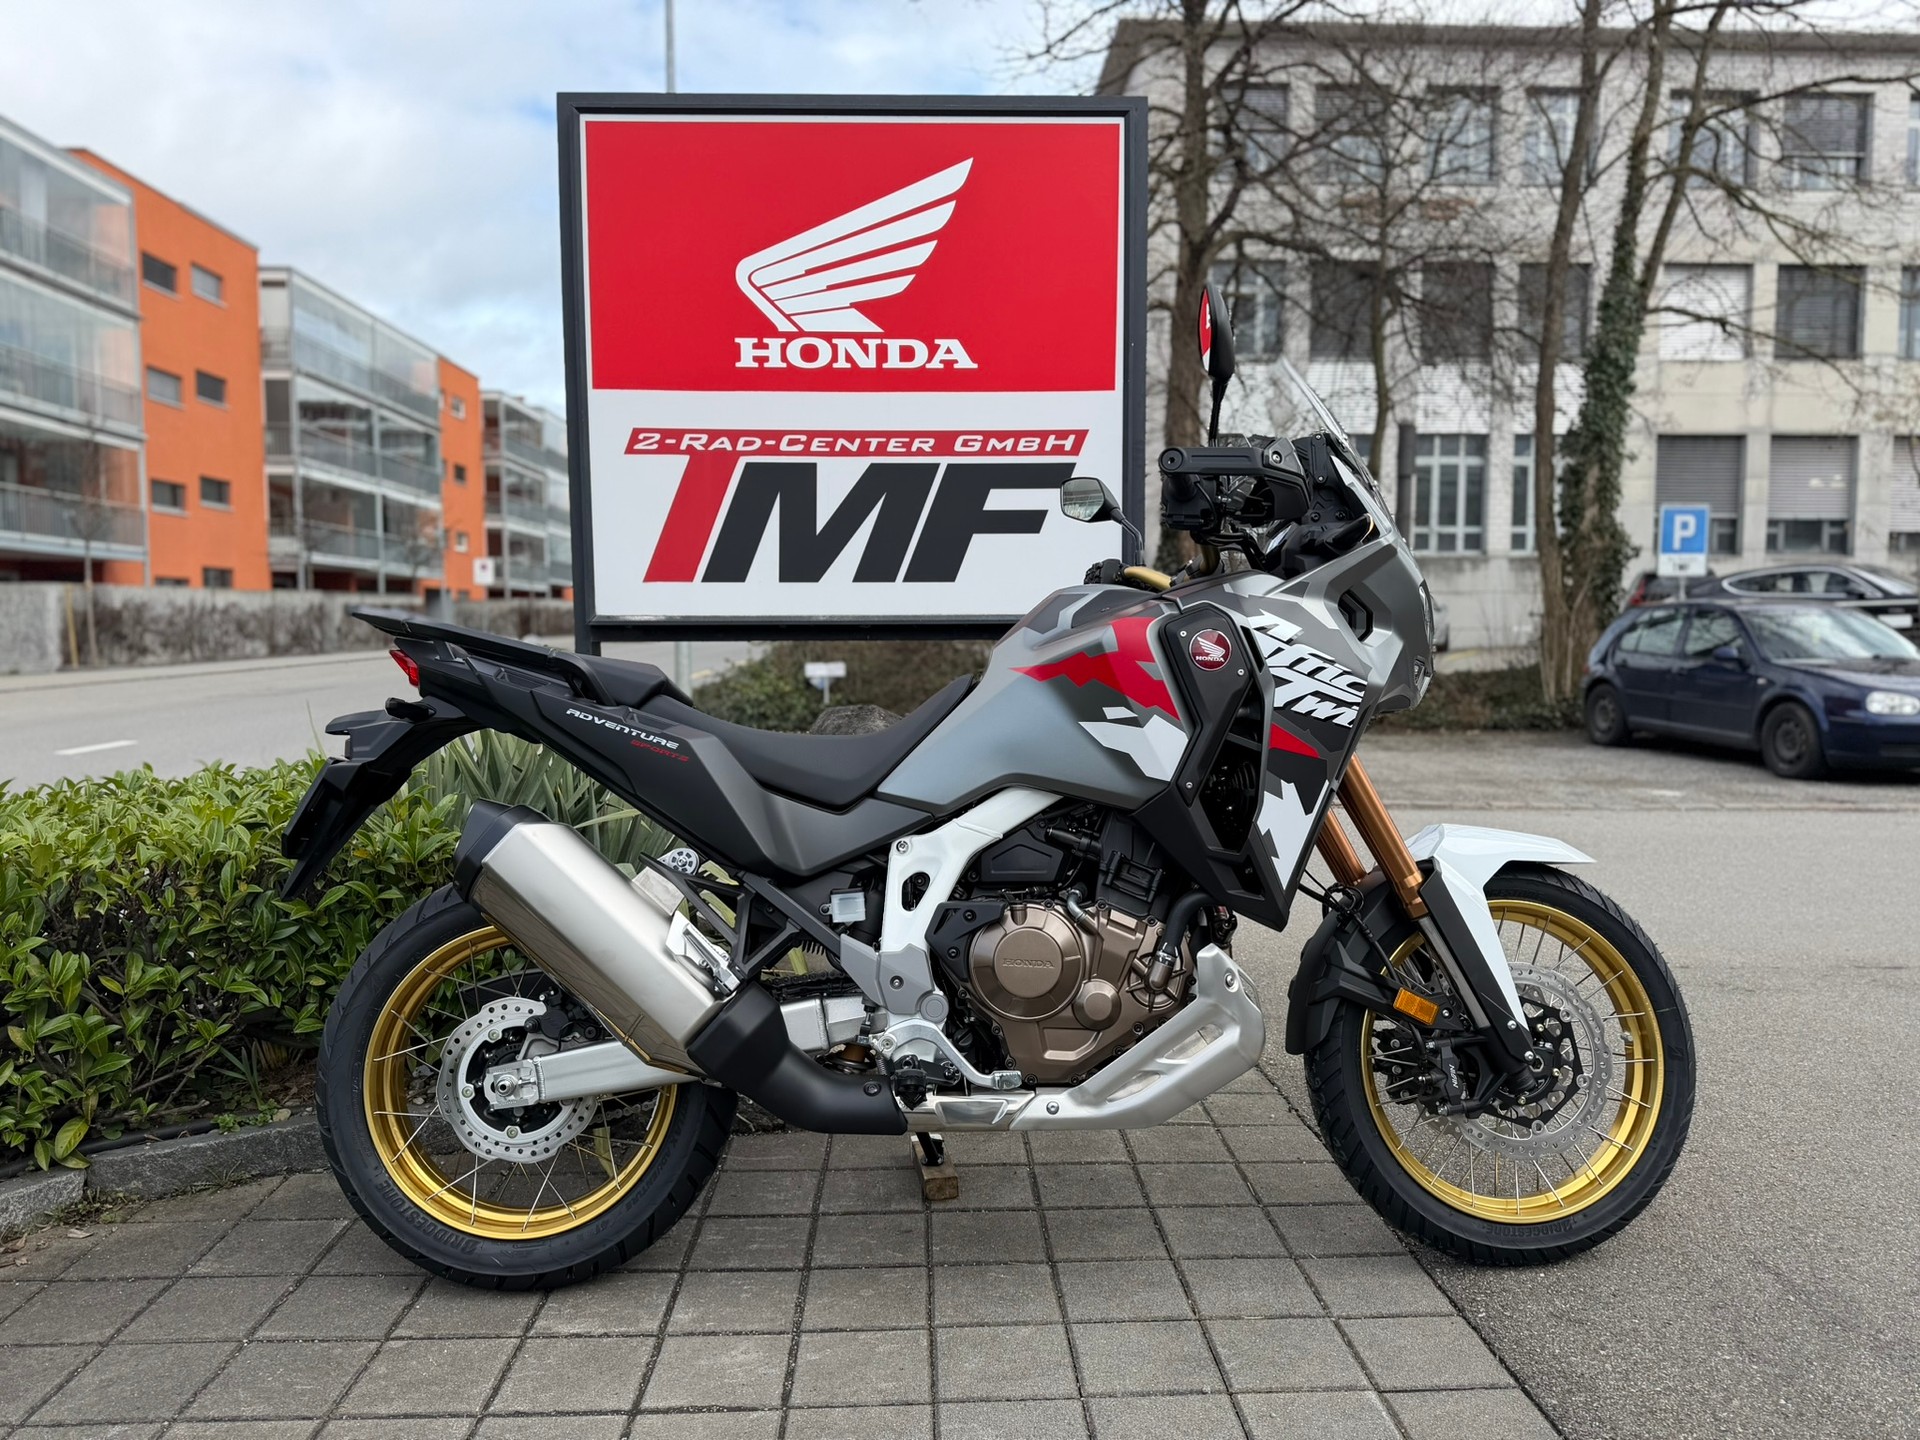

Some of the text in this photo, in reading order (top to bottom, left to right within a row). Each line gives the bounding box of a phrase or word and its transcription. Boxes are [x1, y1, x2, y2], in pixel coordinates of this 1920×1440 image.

[735, 337, 978, 370] HONDA
[643, 453, 1077, 583] TMF
[1672, 513, 1697, 551] P
[1195, 655, 1225, 663] HONDA
[566, 708, 680, 750] ADVENTURE
[630, 739, 689, 762] SPORTS
[1002, 958, 1055, 969] HONDA
[375, 1178, 481, 1256] BRIDGESTONE
[1485, 1217, 1576, 1238] BRIDGESTONE
